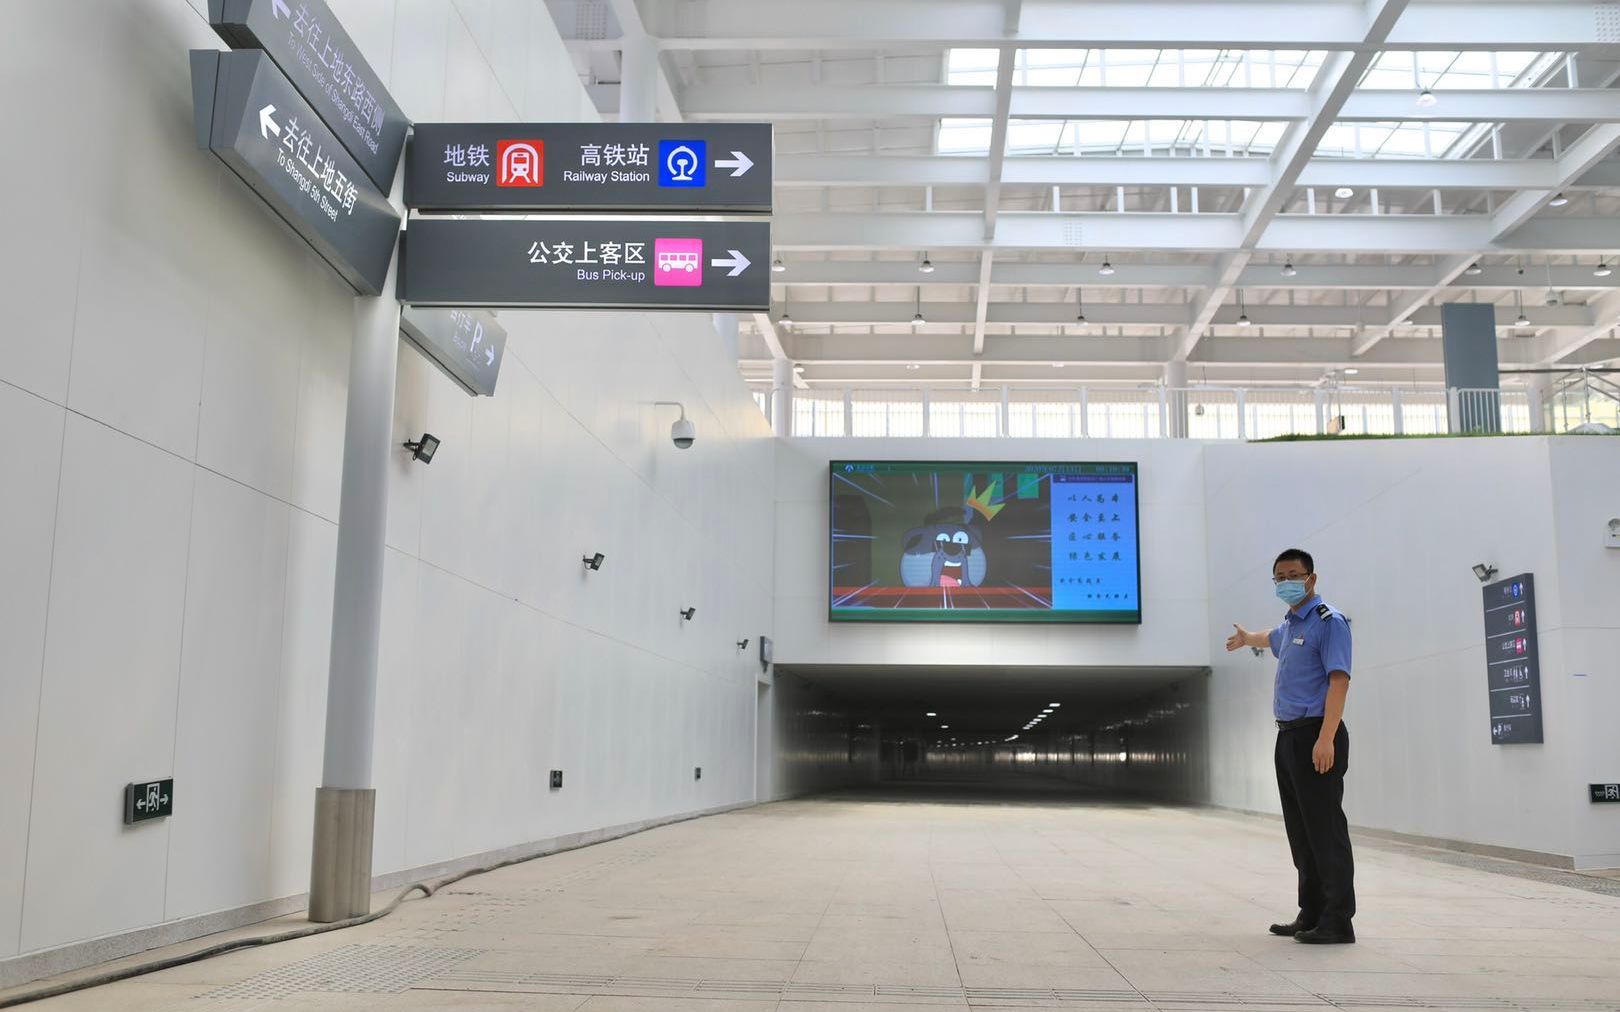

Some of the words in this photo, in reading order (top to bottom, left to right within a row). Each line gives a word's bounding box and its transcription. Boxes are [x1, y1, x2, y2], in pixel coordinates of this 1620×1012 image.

[293, 3, 385, 136] 去往上地东路西侧
[297, 43, 312, 71] West
[312, 63, 325, 87] Side
[331, 89, 354, 124] Shangdi
[352, 115, 365, 139] East
[363, 130, 379, 155] Road
[283, 117, 359, 216] 去往上地五街
[443, 144, 490, 167] 地铁
[580, 143, 649, 167] 高铁站
[277, 147, 286, 167] To
[286, 158, 312, 194] Shangdi
[310, 184, 322, 204] 5th
[320, 195, 339, 223] Street
[446, 171, 490, 185] Subway
[563, 170, 608, 185] Railway
[610, 170, 650, 183] Station
[527, 241, 646, 265] 公交上客区
[576, 269, 600, 281] Bus
[602, 269, 646, 283] Pick-up
[470, 321, 483, 352] P
